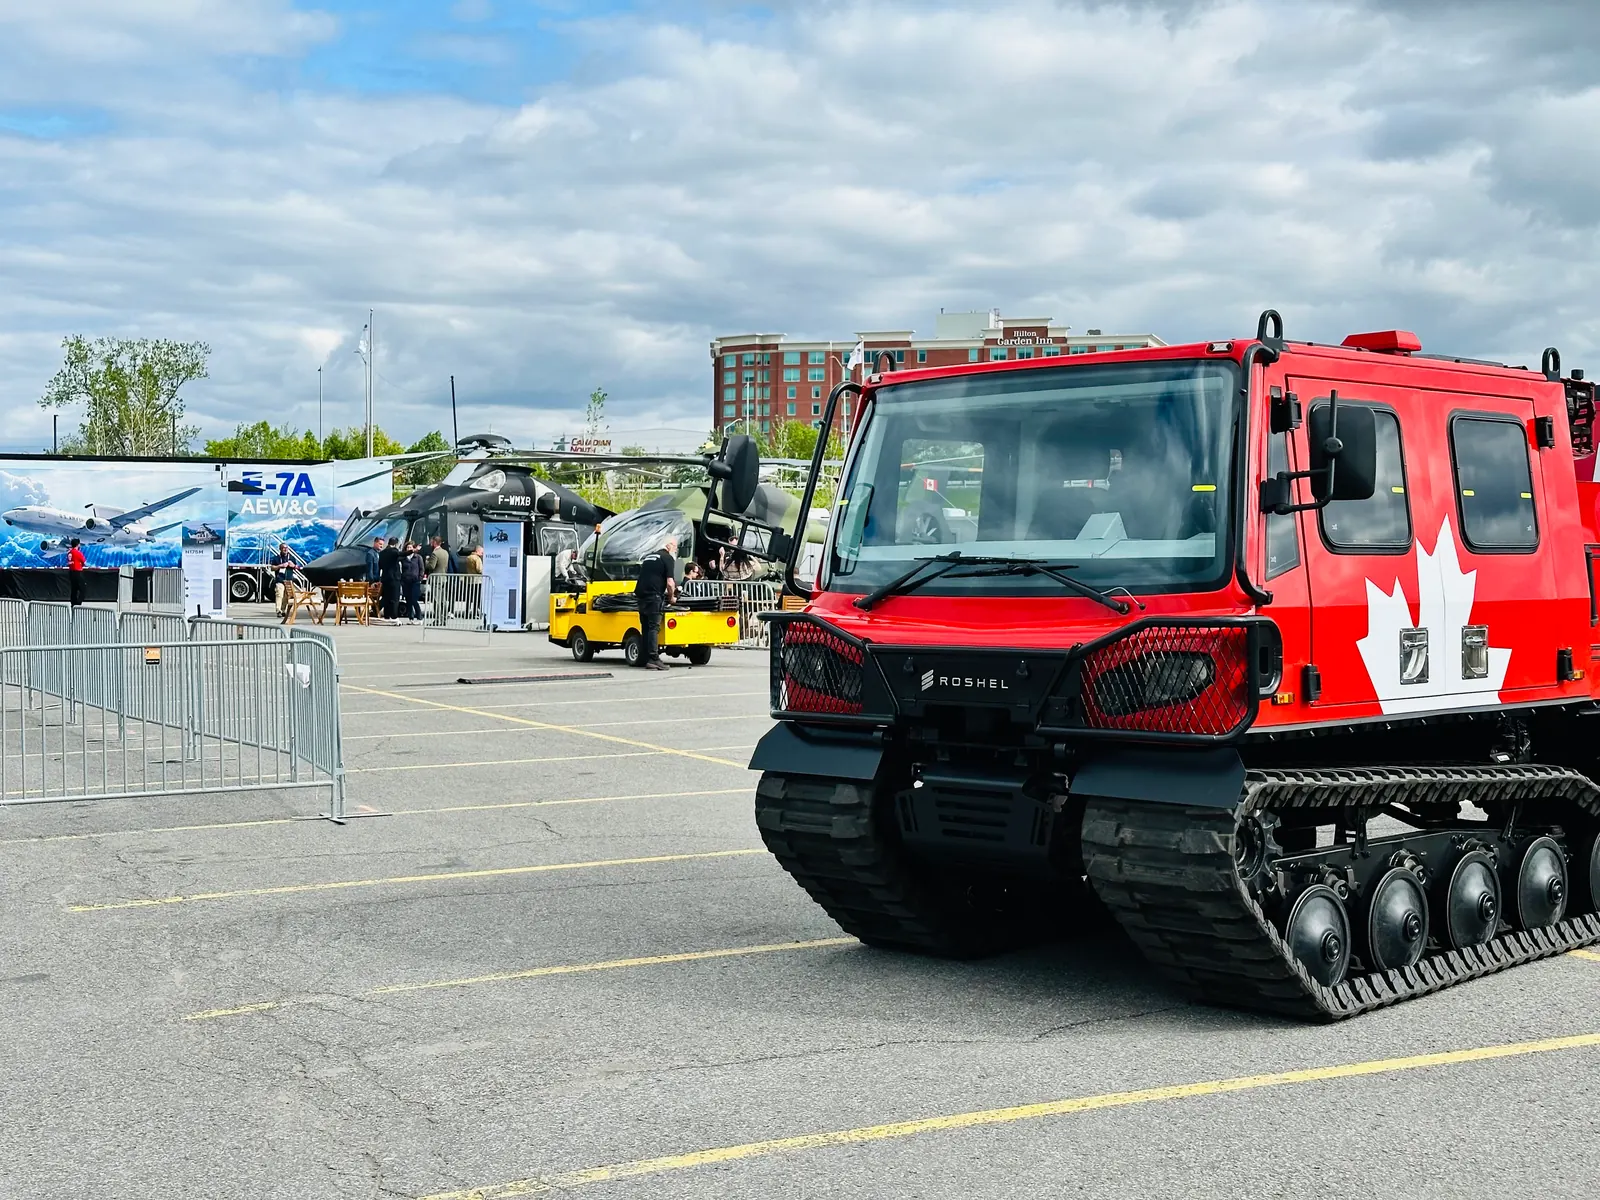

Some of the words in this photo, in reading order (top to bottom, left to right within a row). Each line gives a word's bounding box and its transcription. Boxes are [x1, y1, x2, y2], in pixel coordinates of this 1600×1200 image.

[1013, 330, 1037, 338] Hilton
[997, 337, 1032, 346] Garden
[1035, 336, 1053, 345] Inn
[242, 471, 316, 497] E-7A
[240, 498, 318, 516] AEW&C
[498, 494, 531, 507] F-WMXB
[939, 676, 1009, 689] ROSHEL
